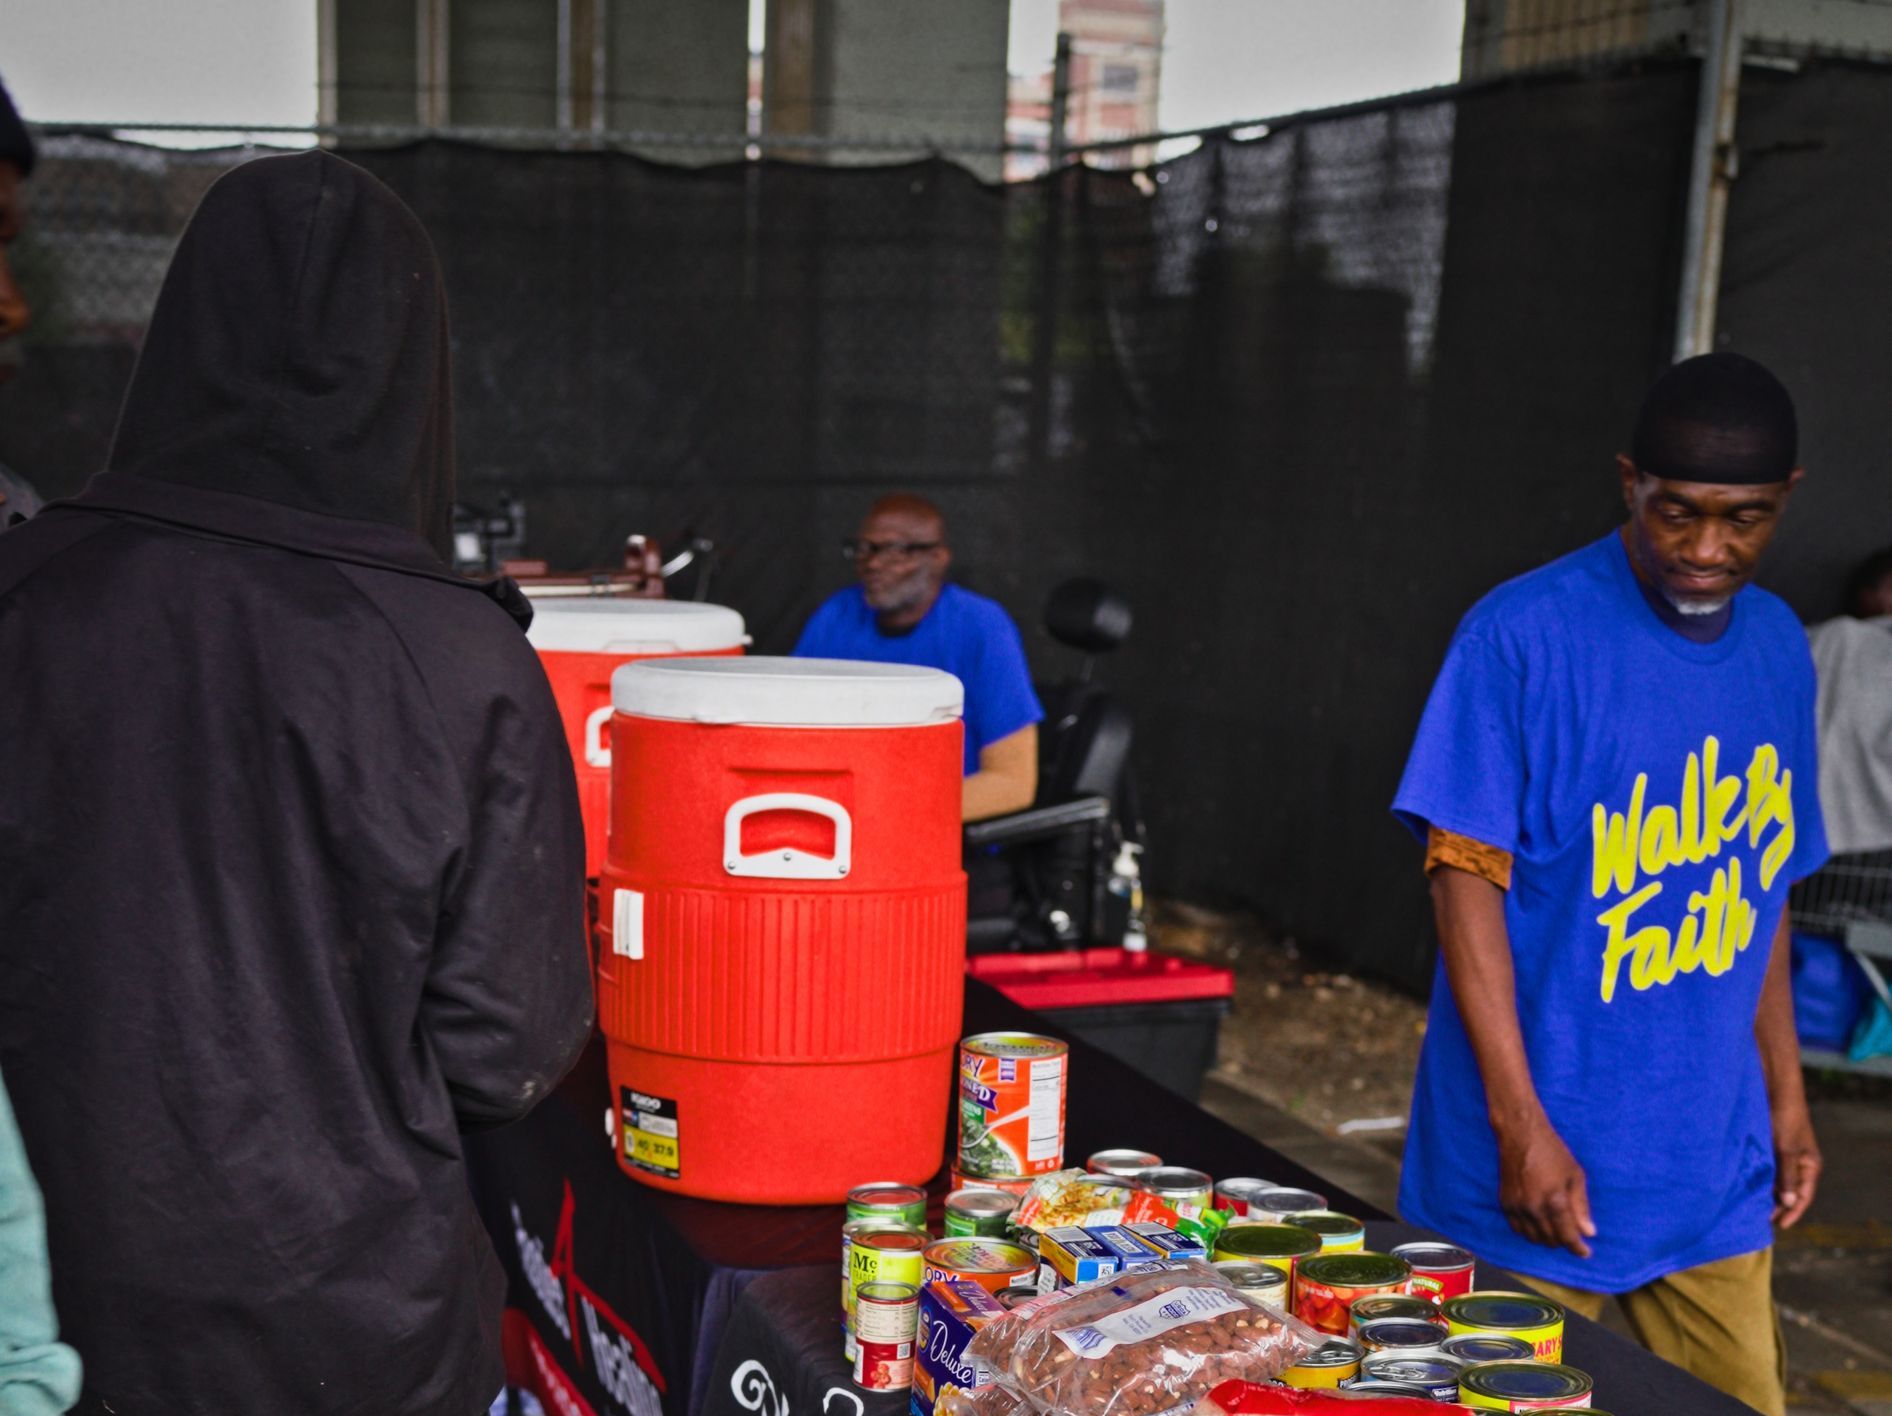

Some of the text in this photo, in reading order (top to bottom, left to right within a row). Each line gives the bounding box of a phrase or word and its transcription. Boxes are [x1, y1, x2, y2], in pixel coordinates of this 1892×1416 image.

[1592, 735, 1747, 898] Walk
[1597, 856, 1757, 1003] Faith
[930, 1321, 972, 1383] Deluxe
